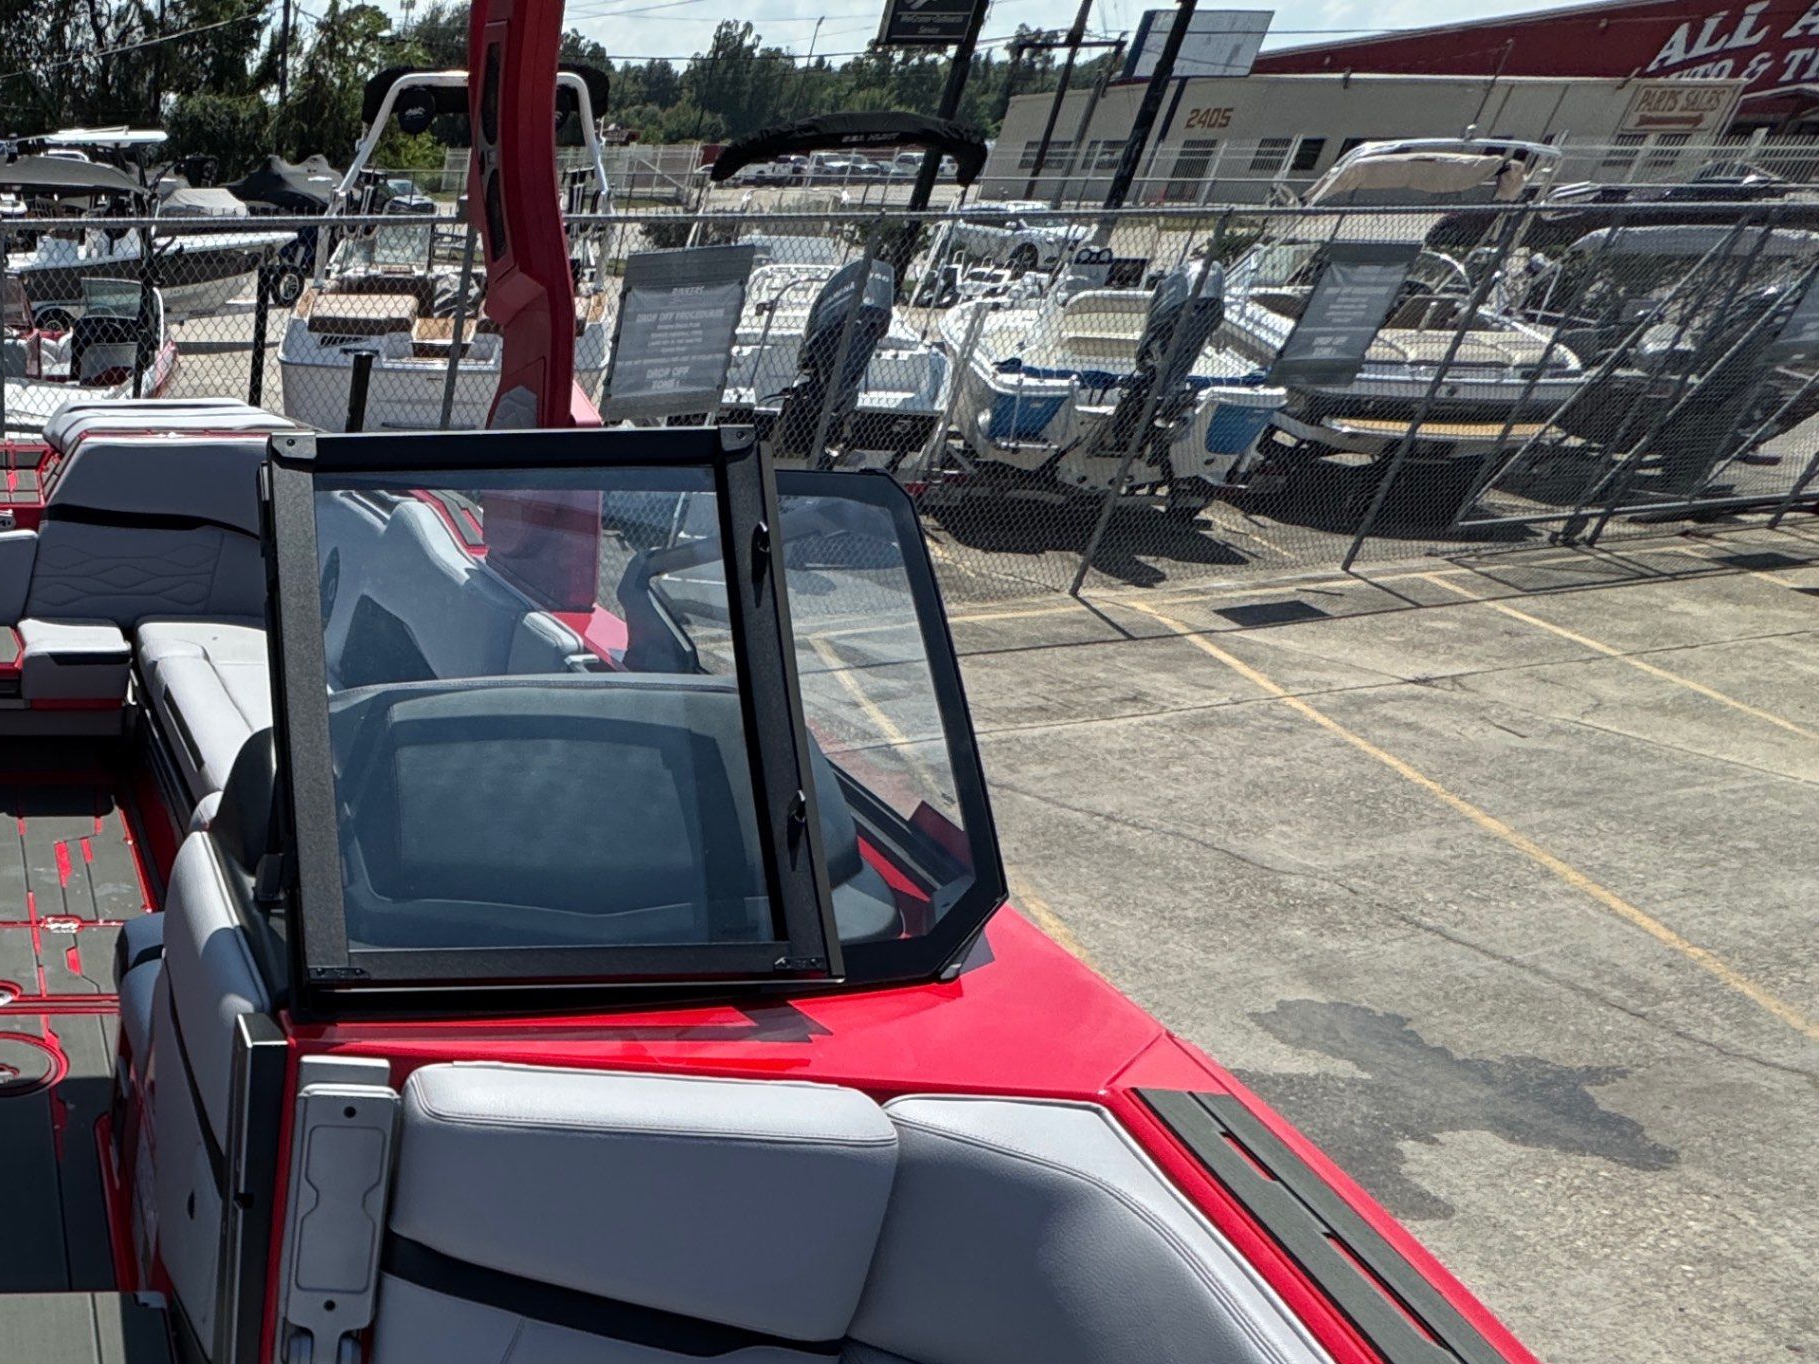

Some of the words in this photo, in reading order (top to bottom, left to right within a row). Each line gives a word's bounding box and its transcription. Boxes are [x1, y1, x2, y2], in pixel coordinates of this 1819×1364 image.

[1646, 1, 1771, 73] ALL
[1634, 89, 1683, 112] PARTS
[1679, 89, 1727, 112] SALES
[1184, 107, 1234, 129] 2405
[646, 367, 671, 379] DROP
[671, 366, 691, 378] OFF
